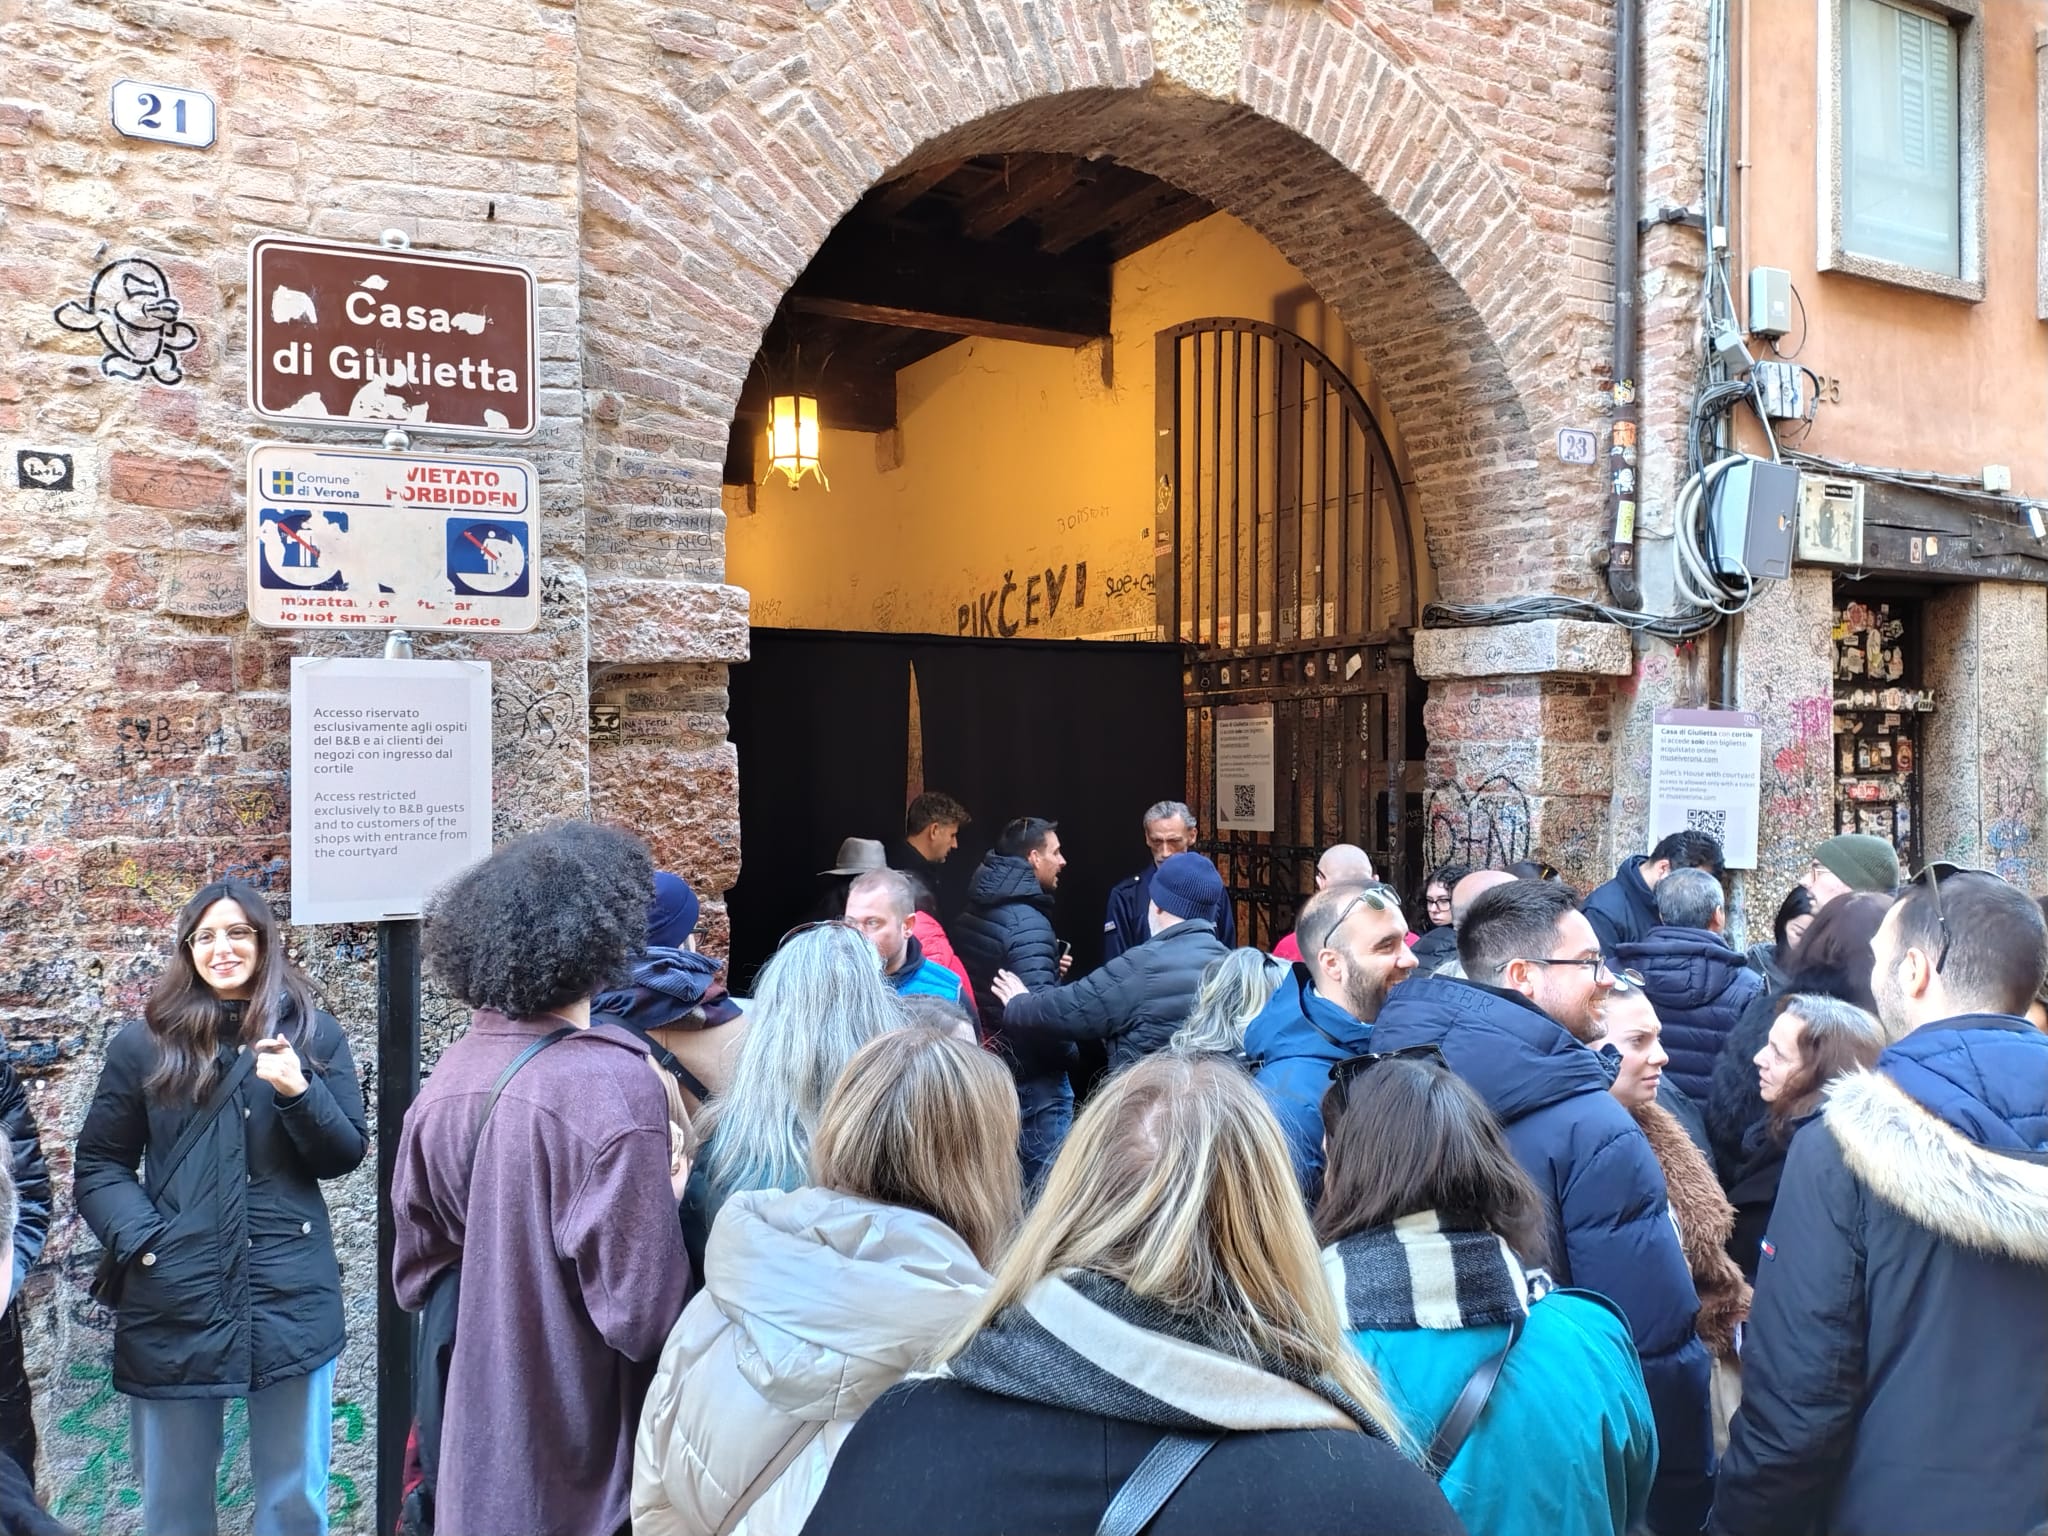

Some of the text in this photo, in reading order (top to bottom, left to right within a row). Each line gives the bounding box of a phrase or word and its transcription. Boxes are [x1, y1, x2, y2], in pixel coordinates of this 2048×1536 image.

[137, 93, 187, 133] 21
[345, 291, 451, 333] Casa
[272, 342, 519, 393] di Giulietta
[297, 472, 350, 484] Comune
[407, 467, 500, 487] VIETATO
[297, 486, 360, 498] di Verona
[958, 561, 1087, 638] PIKČEVI
[314, 708, 420, 718] Accesso riservato
[314, 722, 468, 734] esclusivamente agli ospiti
[1687, 728, 1717, 737] Giulietta
[314, 736, 444, 746] del B&B e ai clienti dei
[314, 749, 453, 762] negozi con ingresso dal
[314, 763, 354, 774] cortile
[314, 790, 417, 802] Access restricted
[314, 803, 465, 817] exclusively to B&B guests
[314, 816, 457, 830] and to customers of the
[314, 829, 468, 845] shops with entrance from
[314, 846, 398, 858] the courtyard
